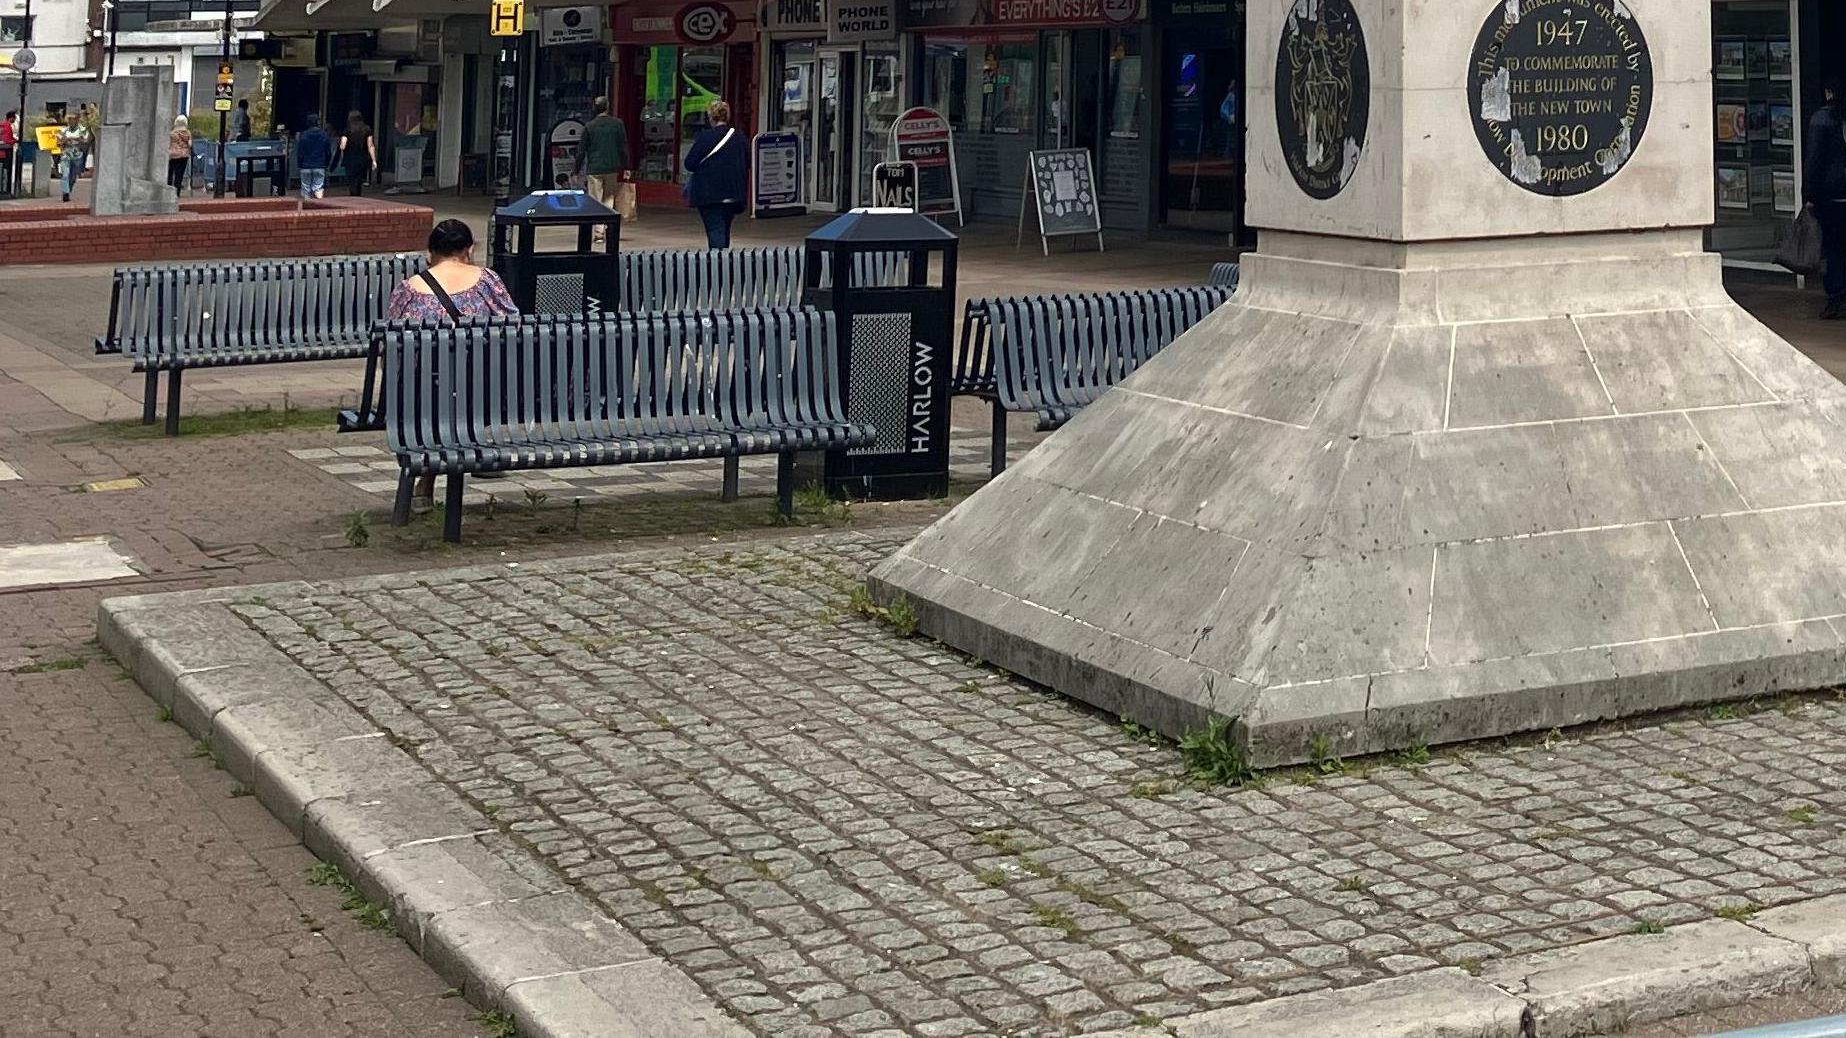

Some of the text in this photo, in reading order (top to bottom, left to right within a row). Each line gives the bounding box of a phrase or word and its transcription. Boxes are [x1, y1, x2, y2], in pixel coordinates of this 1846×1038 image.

[496, 3, 519, 32] H
[838, 5, 889, 19] PHONE
[838, 20, 889, 33] WORLD
[1535, 18, 1589, 47] 1947
[1477, 42, 1501, 77] This
[1594, 2, 1639, 52] erected
[1626, 50, 1642, 74] by
[1504, 54, 1620, 71] TO COMMEMORATE
[1534, 77, 1598, 94] BUILDING
[1601, 76, 1618, 92] OF
[1511, 99, 1613, 116] THE NEW TOWN
[904, 120, 940, 131] CELLY'S
[1535, 124, 1589, 152] 1980
[908, 146, 941, 155] CELLY'S
[911, 341, 934, 454] HARLOW
